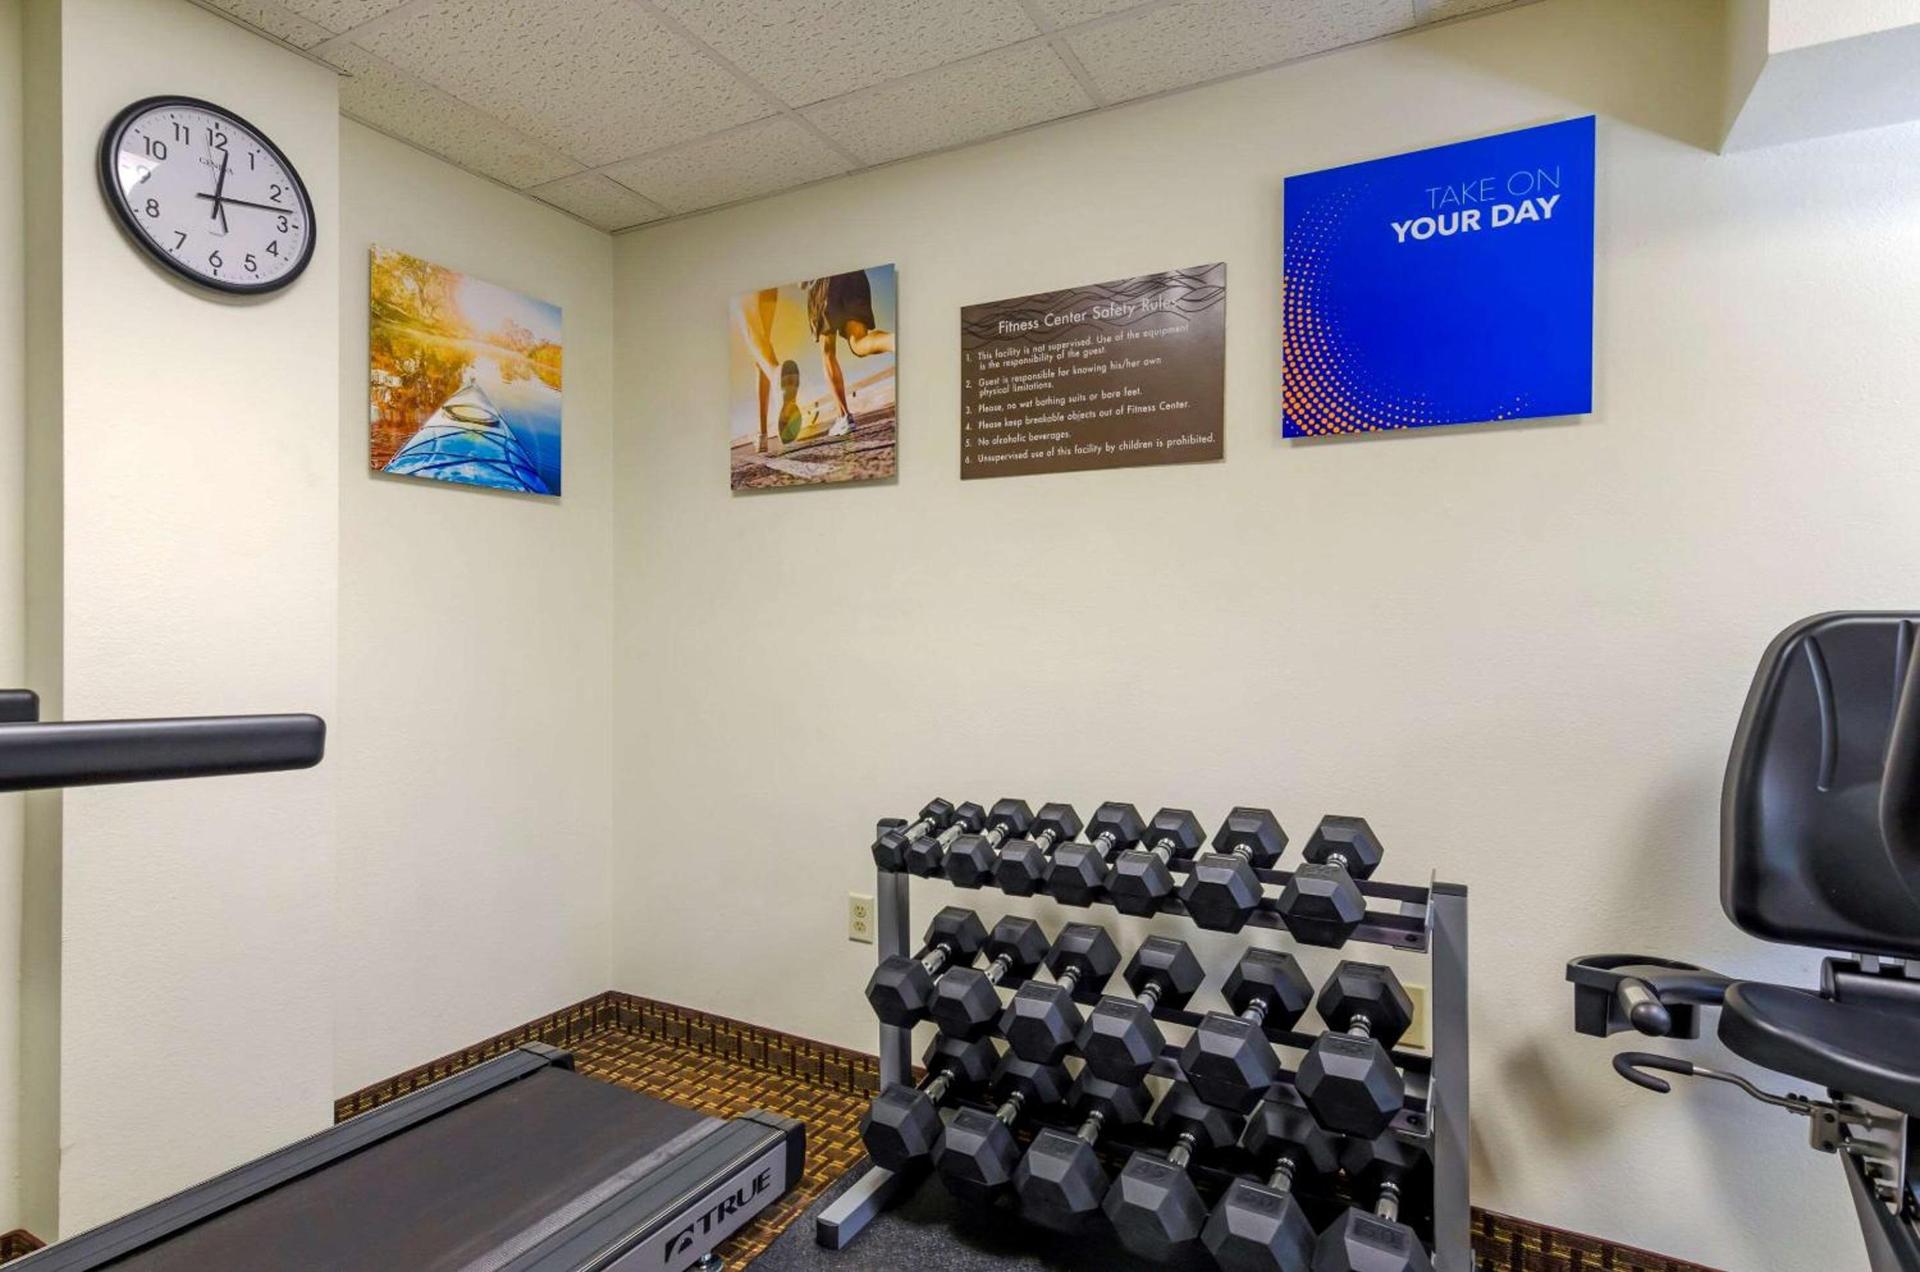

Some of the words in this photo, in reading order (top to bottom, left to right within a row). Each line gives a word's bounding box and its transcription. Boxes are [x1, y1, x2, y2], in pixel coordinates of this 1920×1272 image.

[173, 122, 189, 145] 11
[207, 128, 228, 151] 12
[143, 136, 167, 160] 10
[248, 152, 254, 170] 1
[270, 184, 282, 203] 2
[1425, 177, 1496, 211] TAKE
[1507, 165, 1560, 196] ON
[146, 198, 160, 218] 8
[1391, 209, 1481, 243] YOUR
[1492, 194, 1560, 228] DAY
[277, 215, 288, 233] 3
[174, 230, 187, 250] 7
[266, 240, 278, 257] 4
[209, 250, 223, 268] 6
[244, 254, 257, 272] 5
[998, 319, 1039, 334] Fitness
[1044, 311, 1088, 327] Center
[1092, 302, 1136, 319] Safety
[1142, 296, 1178, 311] Rules
[978, 350, 993, 361] This
[995, 346, 1021, 359] facility
[1023, 345, 1030, 354] is
[1032, 343, 1046, 353] not
[1096, 333, 1112, 344] Use
[1115, 331, 1124, 342] of
[1127, 329, 1140, 339] the
[1143, 323, 1189, 339] equipment
[980, 362, 986, 371] is
[988, 359, 1001, 369] the
[1003, 350, 1053, 368] responsibility
[1056, 349, 1065, 360] of
[1067, 348, 1080, 358] the
[978, 376, 1000, 387] Guest
[1002, 375, 1009, 384] is
[1011, 368, 1055, 384] responsible
[1058, 366, 1070, 377] for
[1073, 362, 1107, 375] knowing
[1110, 358, 1141, 370] his/her
[1143, 357, 1162, 367] own
[978, 403, 1005, 414] Please,
[1020, 399, 1033, 409] wet
[1035, 396, 1066, 407] bathing
[1068, 393, 1086, 403] suits
[1089, 393, 1098, 401] or
[1101, 389, 1121, 400] bare
[1124, 386, 1143, 397] feet.
[979, 384, 1010, 399] physical
[1013, 381, 1054, 393] limitations.
[978, 419, 1002, 429] Please
[1004, 417, 1022, 428] keep
[1025, 411, 1065, 425] breakable
[1067, 409, 1097, 421] objects
[1099, 408, 1113, 418] out
[1116, 405, 1124, 416] of
[1127, 403, 1157, 415] Fitness
[1159, 400, 1191, 411] Center.
[978, 437, 990, 446] No
[992, 433, 1027, 445] alcoholic
[1029, 431, 1071, 442] beverages.
[978, 448, 1029, 464] Unsupervised
[1031, 450, 1045, 459] use
[1047, 447, 1055, 457] of
[1058, 445, 1072, 456] this
[1074, 442, 1102, 456] facility
[1105, 441, 1116, 453] by
[1119, 439, 1153, 451] children
[1156, 438, 1163, 447] is
[1167, 431, 1216, 448] prohibited.
[697, 1167, 771, 1234] TRUE
